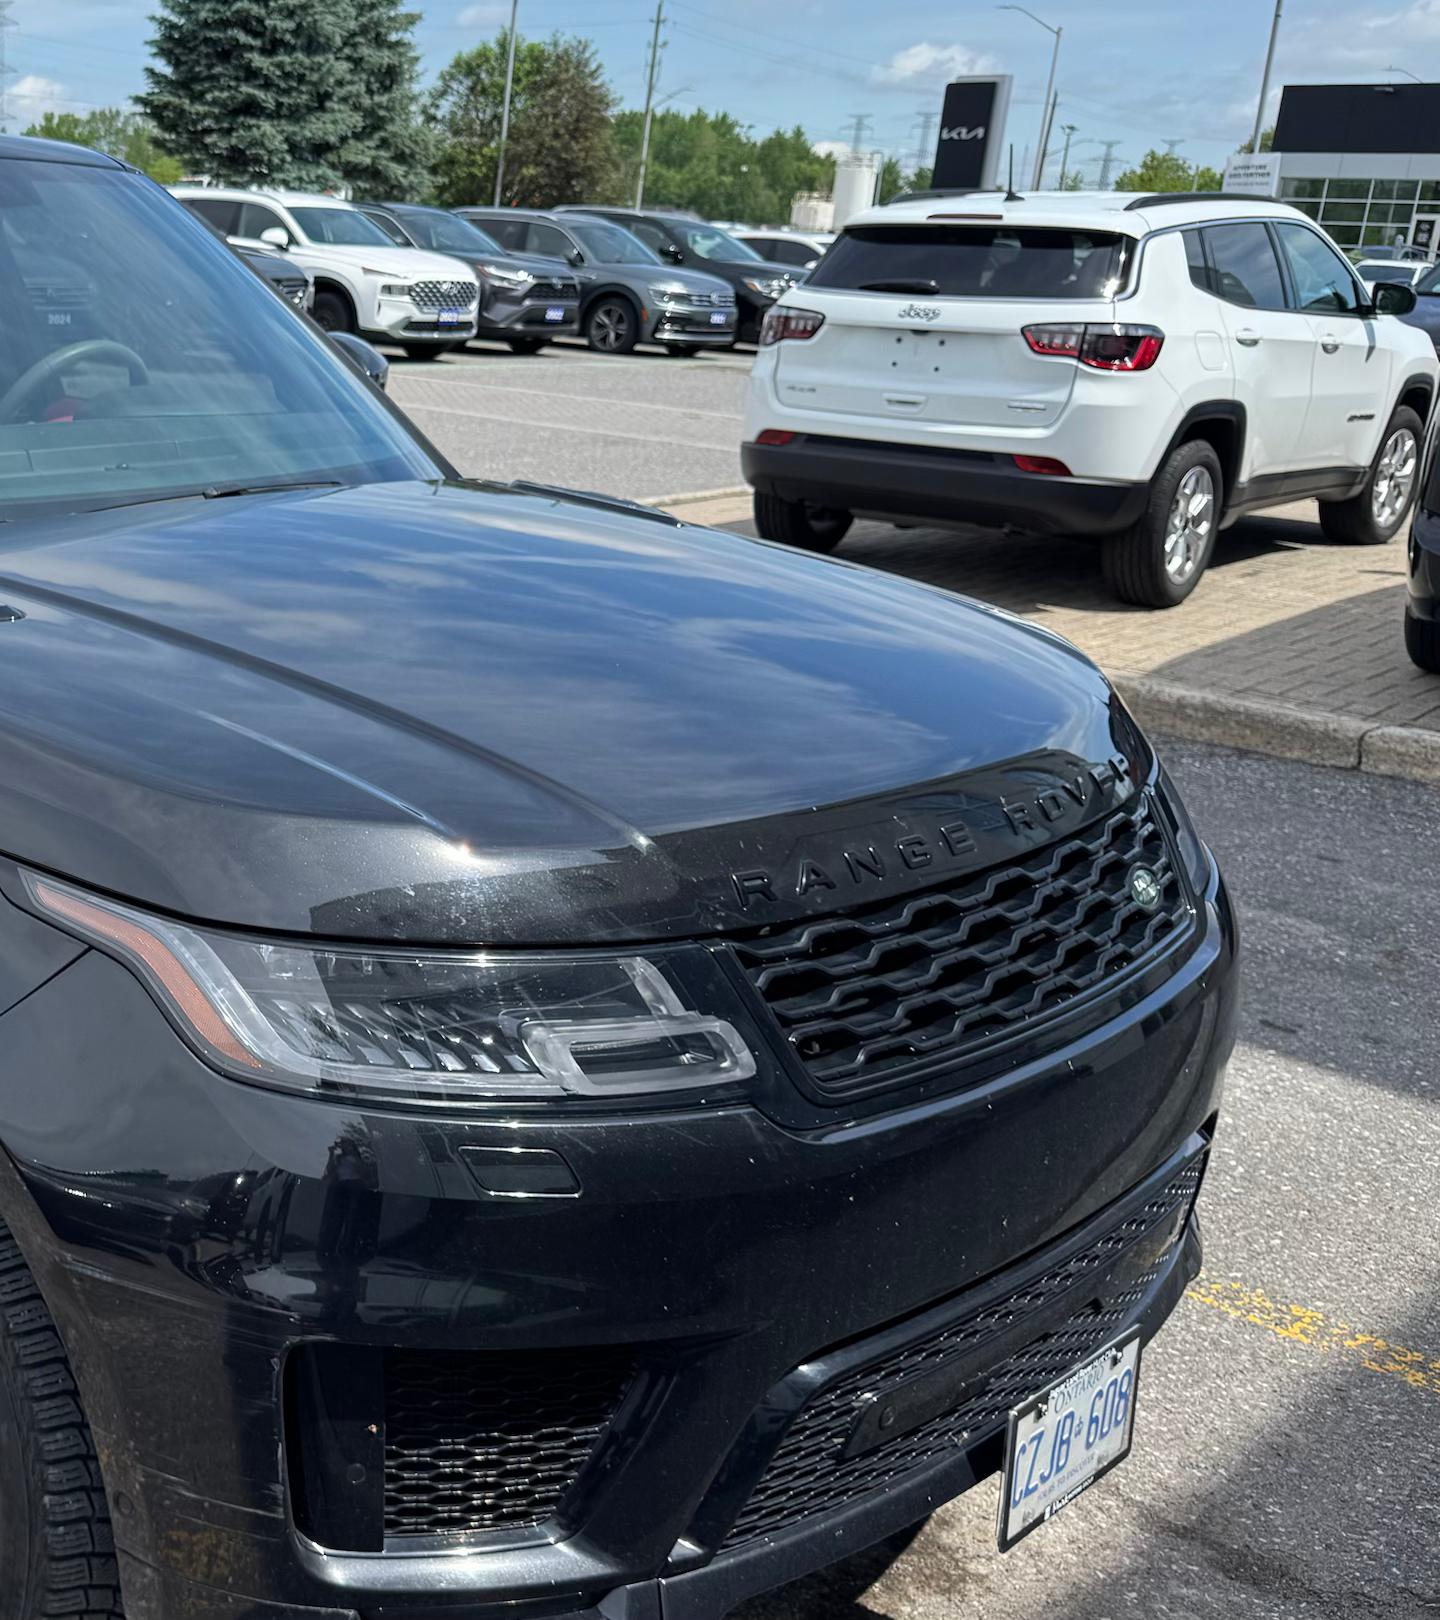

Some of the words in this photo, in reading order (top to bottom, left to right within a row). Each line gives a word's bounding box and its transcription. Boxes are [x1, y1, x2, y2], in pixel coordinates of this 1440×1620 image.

[897, 303, 941, 322] Jeep
[730, 821, 978, 911] RANGE
[1002, 751, 1133, 837] ROVER
[1010, 1408, 1075, 1509] CZJB
[1084, 1366, 1133, 1451] 608
